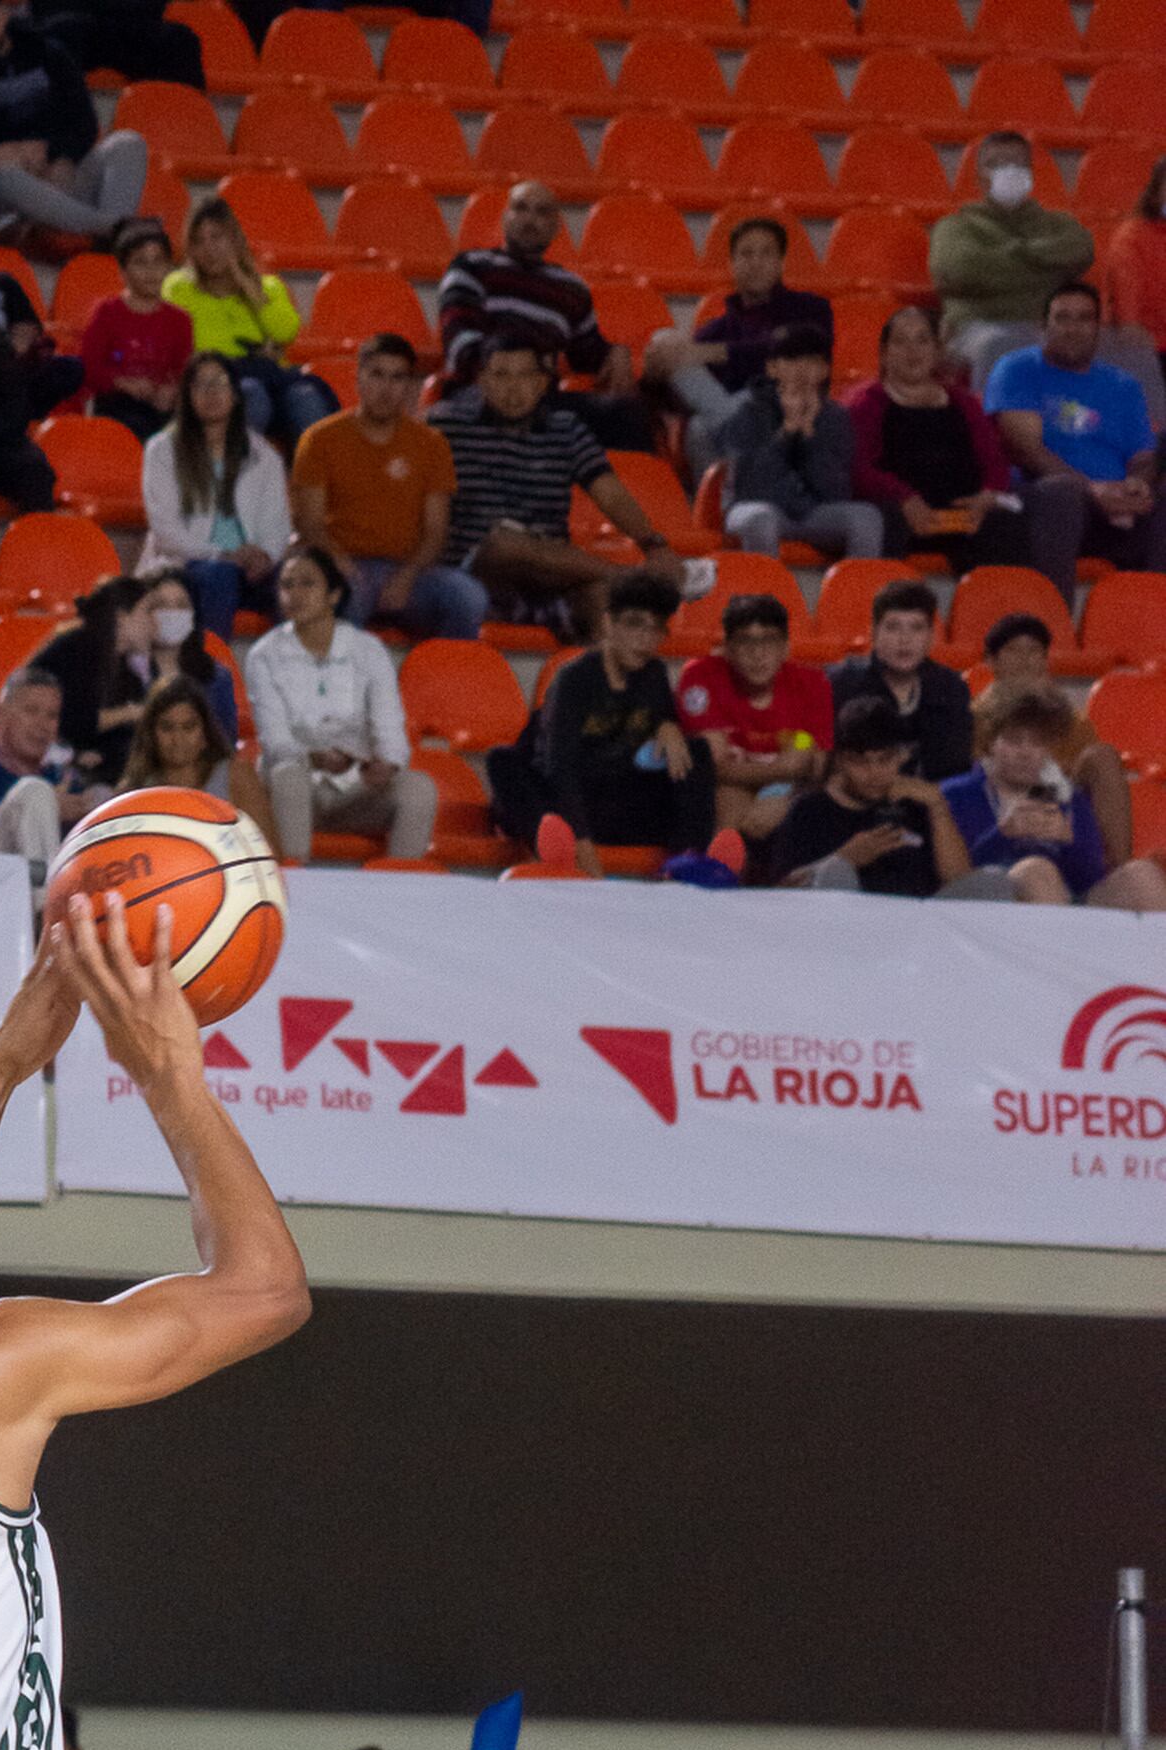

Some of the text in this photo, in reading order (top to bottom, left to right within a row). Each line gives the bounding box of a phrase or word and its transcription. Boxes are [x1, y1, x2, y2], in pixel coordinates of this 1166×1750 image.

[691, 1029, 915, 1069] GOBIERNO DE
[254, 1085, 308, 1114] que
[320, 1083, 372, 1112] late
[692, 1063, 924, 1111] LA RIOJA
[1072, 1153, 1106, 1178] LA
